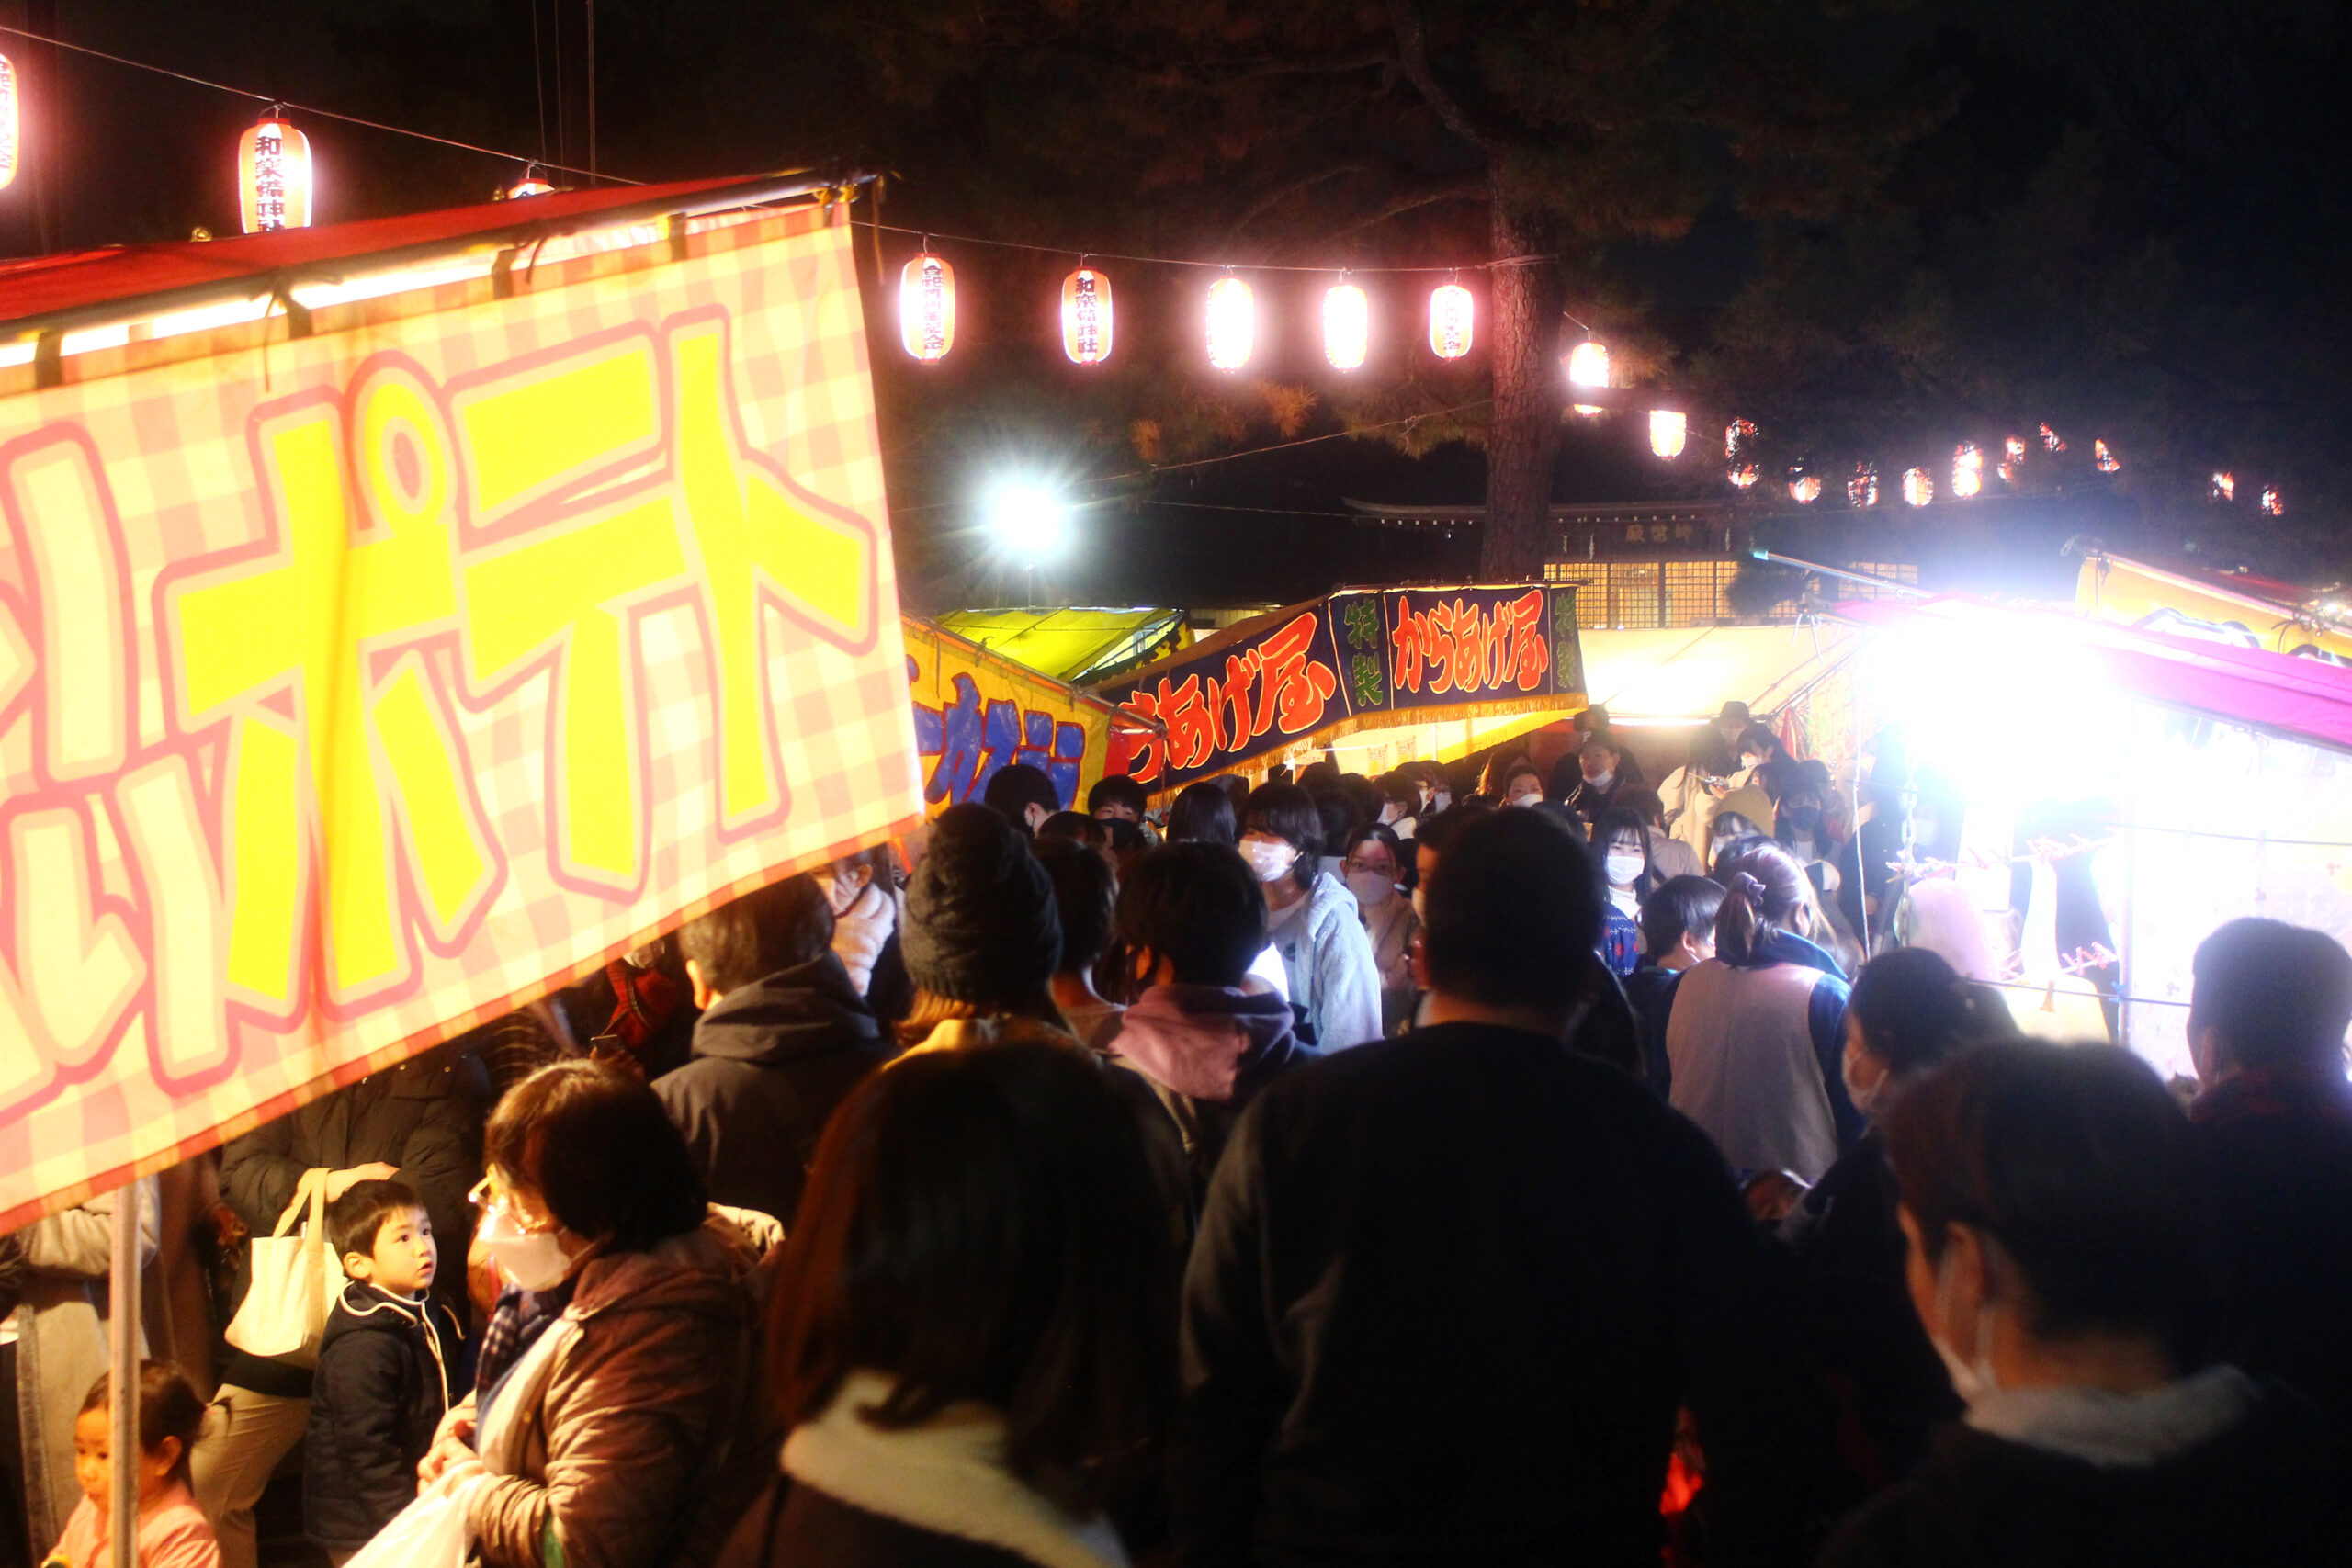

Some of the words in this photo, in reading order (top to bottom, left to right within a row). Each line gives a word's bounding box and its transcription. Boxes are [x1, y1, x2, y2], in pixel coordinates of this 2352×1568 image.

[153, 303, 877, 1026] ポテト
[1344, 597, 1383, 706] 特製
[1392, 589, 1549, 693] からあげ屋
